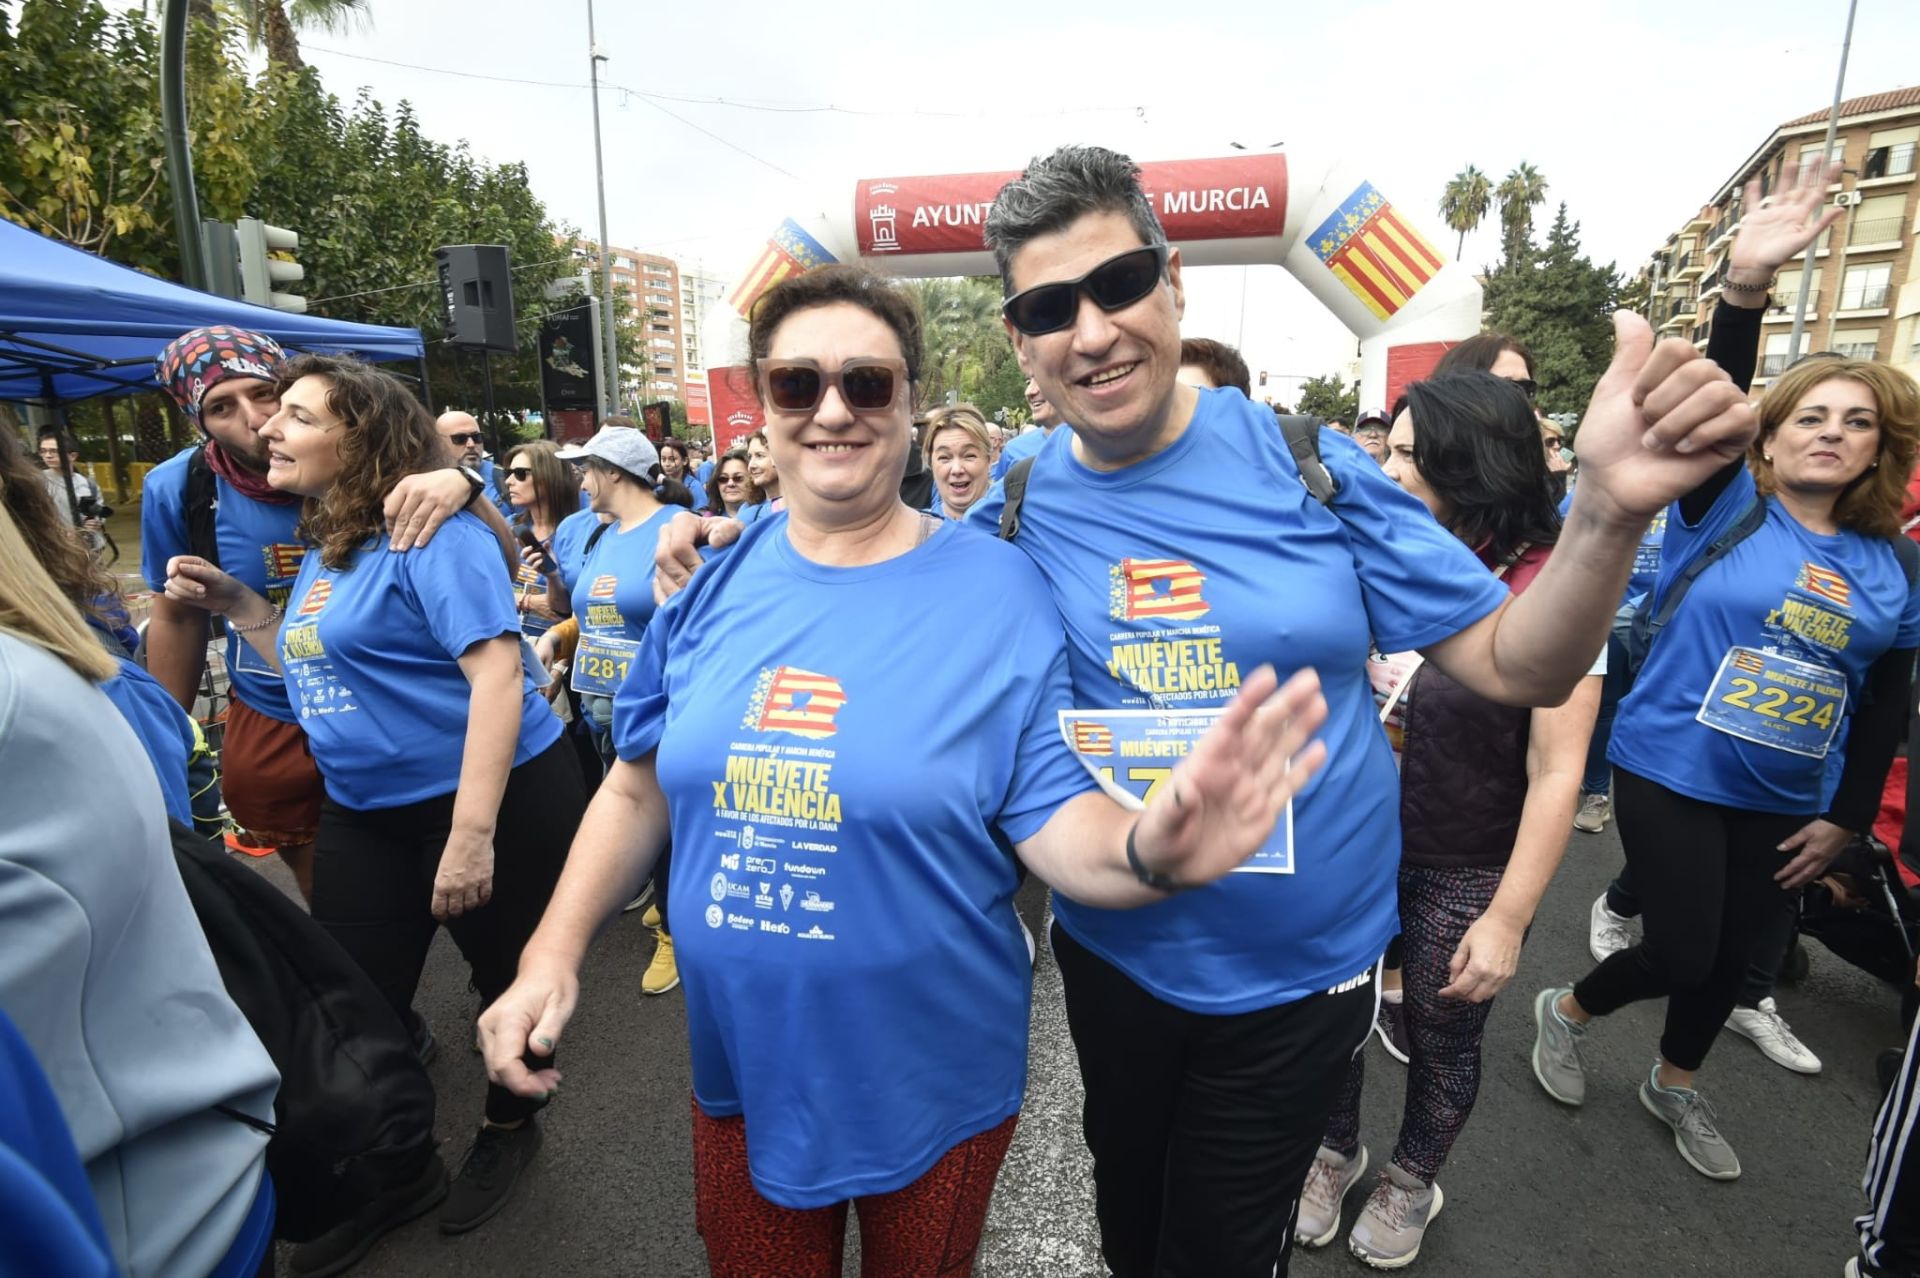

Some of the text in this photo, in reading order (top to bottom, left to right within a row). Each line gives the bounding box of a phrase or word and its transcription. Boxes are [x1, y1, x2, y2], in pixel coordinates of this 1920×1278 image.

[1163, 186, 1270, 214] MURCIA
[1109, 631, 1135, 641] CARRERA
[1135, 630, 1161, 639] POPULAR
[1764, 609, 1851, 650] X VALENCIA
[1112, 638, 1223, 670] MUÉVETE
[579, 655, 628, 681] 1281
[1193, 690, 1208, 700] POR
[1209, 689, 1218, 699] LA
[1219, 687, 1238, 698] DANA
[1721, 677, 1835, 730] 2224
[755, 743, 780, 753] POPULAR
[1120, 738, 1188, 757] MUÉVETE
[725, 753, 832, 793] MUÉVETE
[712, 781, 842, 823] X VALENCIA
[720, 810, 739, 820] FAVOR
[740, 812, 748, 822] DE
[749, 813, 760, 823] LOS
[759, 814, 794, 828] AFECTADOS
[794, 818, 808, 828] POR
[808, 819, 817, 830] LA
[818, 821, 838, 832] DANA
[802, 841, 838, 853] VERDAD
[783, 862, 826, 875] fundown
[727, 882, 750, 892] UCAM
